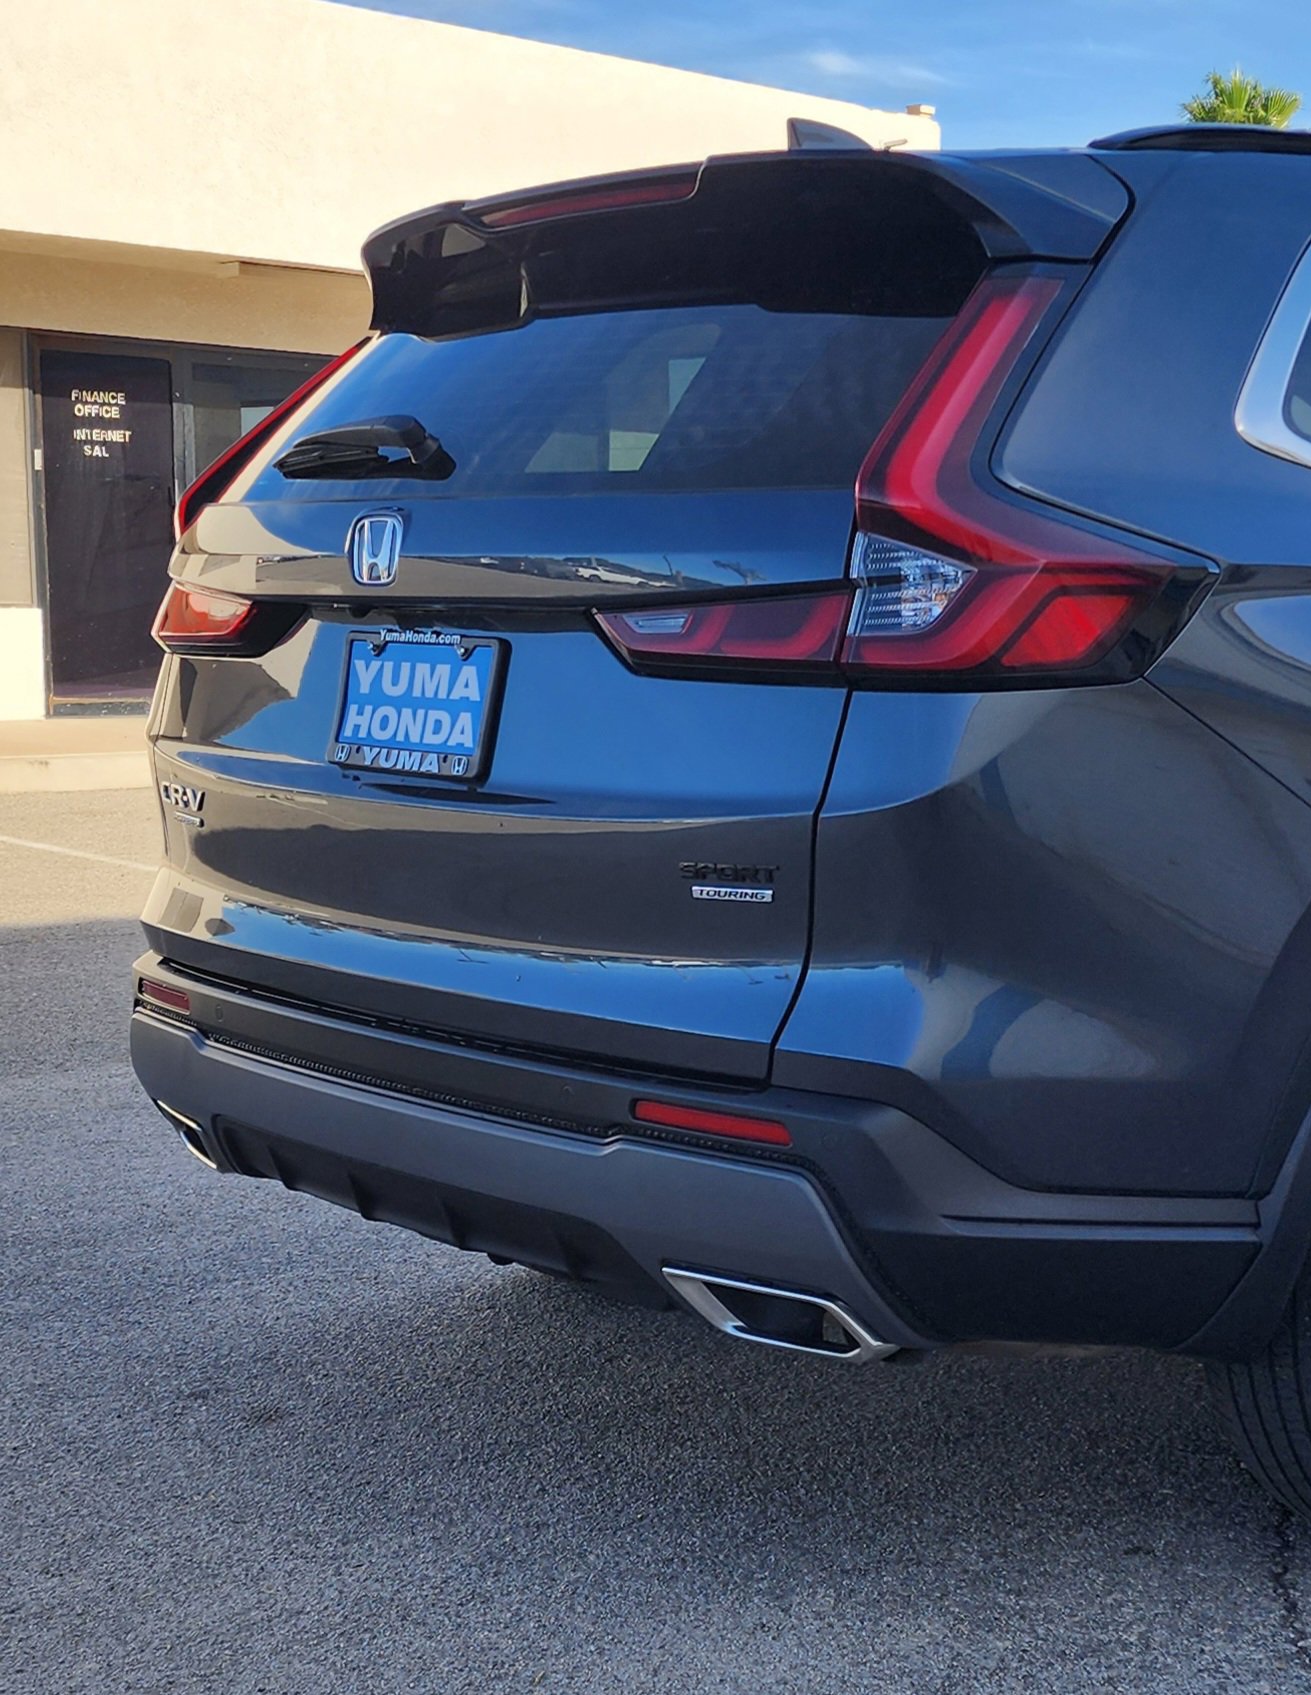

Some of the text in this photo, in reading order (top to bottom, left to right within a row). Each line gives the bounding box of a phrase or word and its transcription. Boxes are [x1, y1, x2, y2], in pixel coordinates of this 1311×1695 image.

[71, 389, 126, 405] FINANCE
[74, 403, 120, 418] OFFICE
[73, 428, 132, 442] INTERNET
[83, 445, 110, 457] SAL
[380, 628, 461, 644] YumaHonda.com
[354, 659, 481, 701] YUMA
[344, 704, 474, 748] HONDA
[362, 746, 440, 773] YUMA
[680, 861, 780, 883] SPORT
[698, 888, 766, 900] TOURING
